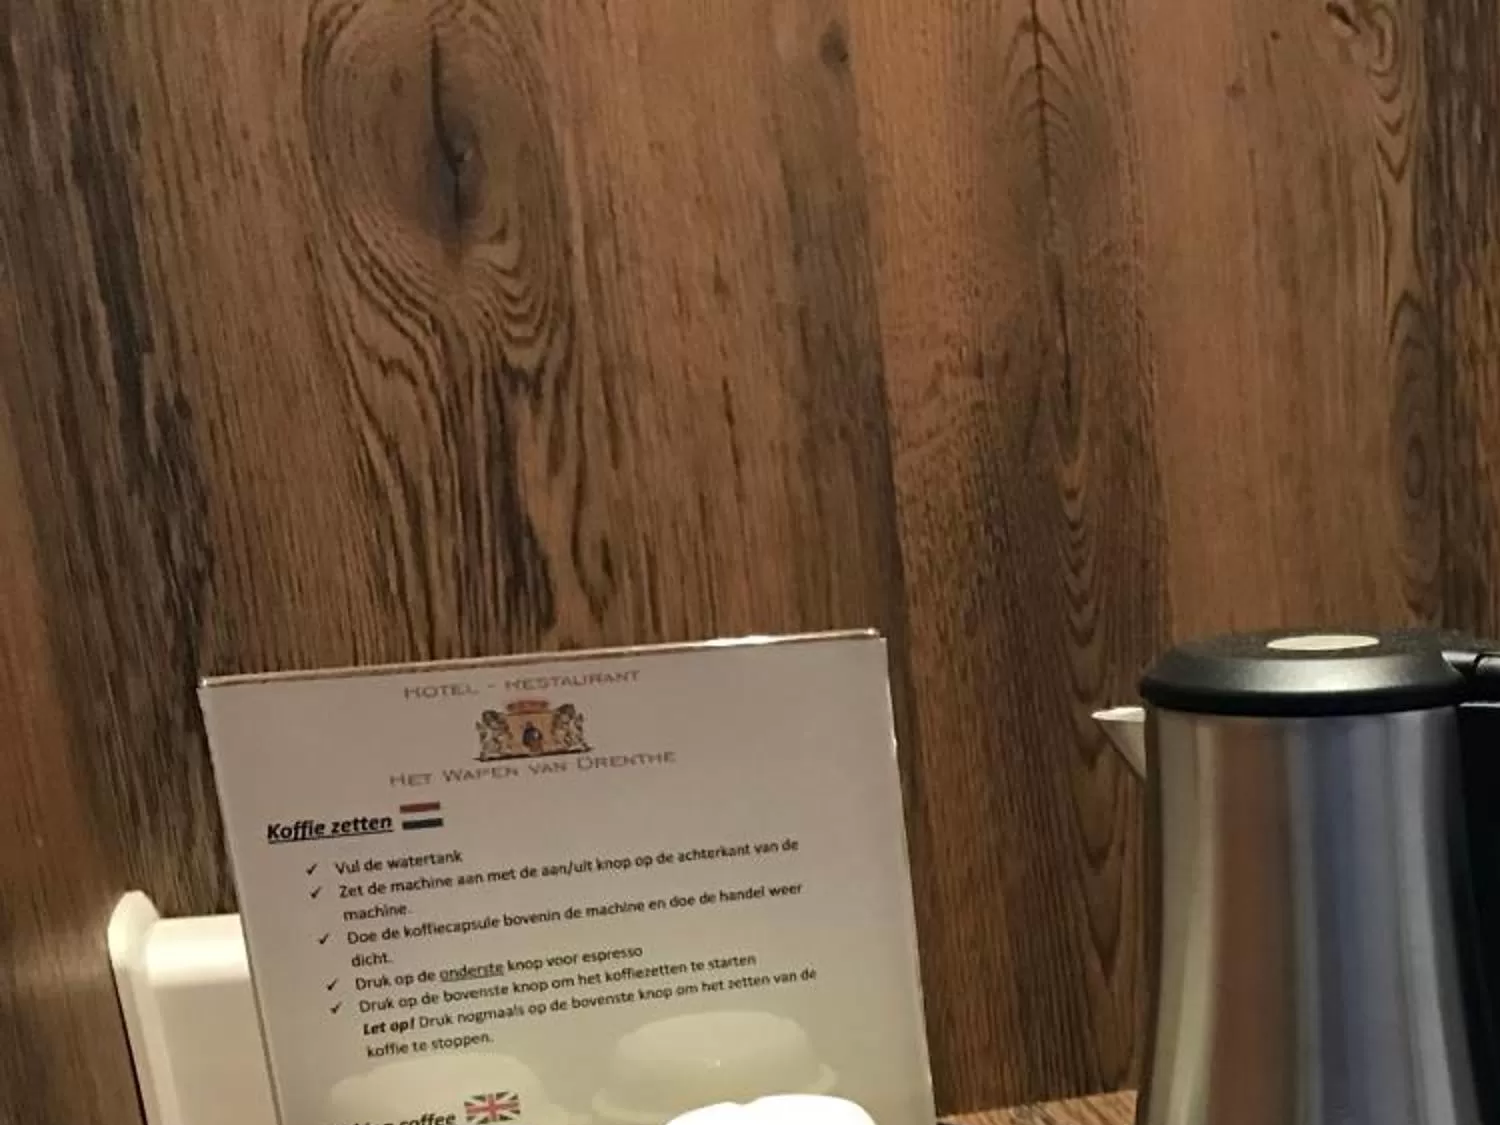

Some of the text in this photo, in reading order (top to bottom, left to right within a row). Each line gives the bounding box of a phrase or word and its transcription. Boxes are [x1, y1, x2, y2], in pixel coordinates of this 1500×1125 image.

[403, 683, 479, 701] HOTEL
[504, 669, 641, 691] RESTAURANT
[389, 772, 433, 788] HET
[441, 767, 519, 783] WAPEN
[576, 751, 676, 771] DRENTHE
[266, 816, 395, 844] Koffie zetten
[334, 849, 463, 875] Vul de watertank
[338, 838, 799, 899] Zet de machine aan met de aan/uit knop op de achterkant van de
[346, 883, 802, 945] Doe de koffiecapsule bovenin de machine en doe de handel weer
[351, 952, 393, 968] dicht.
[355, 947, 644, 991] Druk op de onderste knop voor espresso
[358, 955, 757, 1014] Druk op de bovenste knop om het koffiezetten te starten
[363, 967, 817, 1036] Let op! Druk nogmaals op de bovenste knop om het zetten van de
[366, 1033, 494, 1058] koffie te stoppen.
